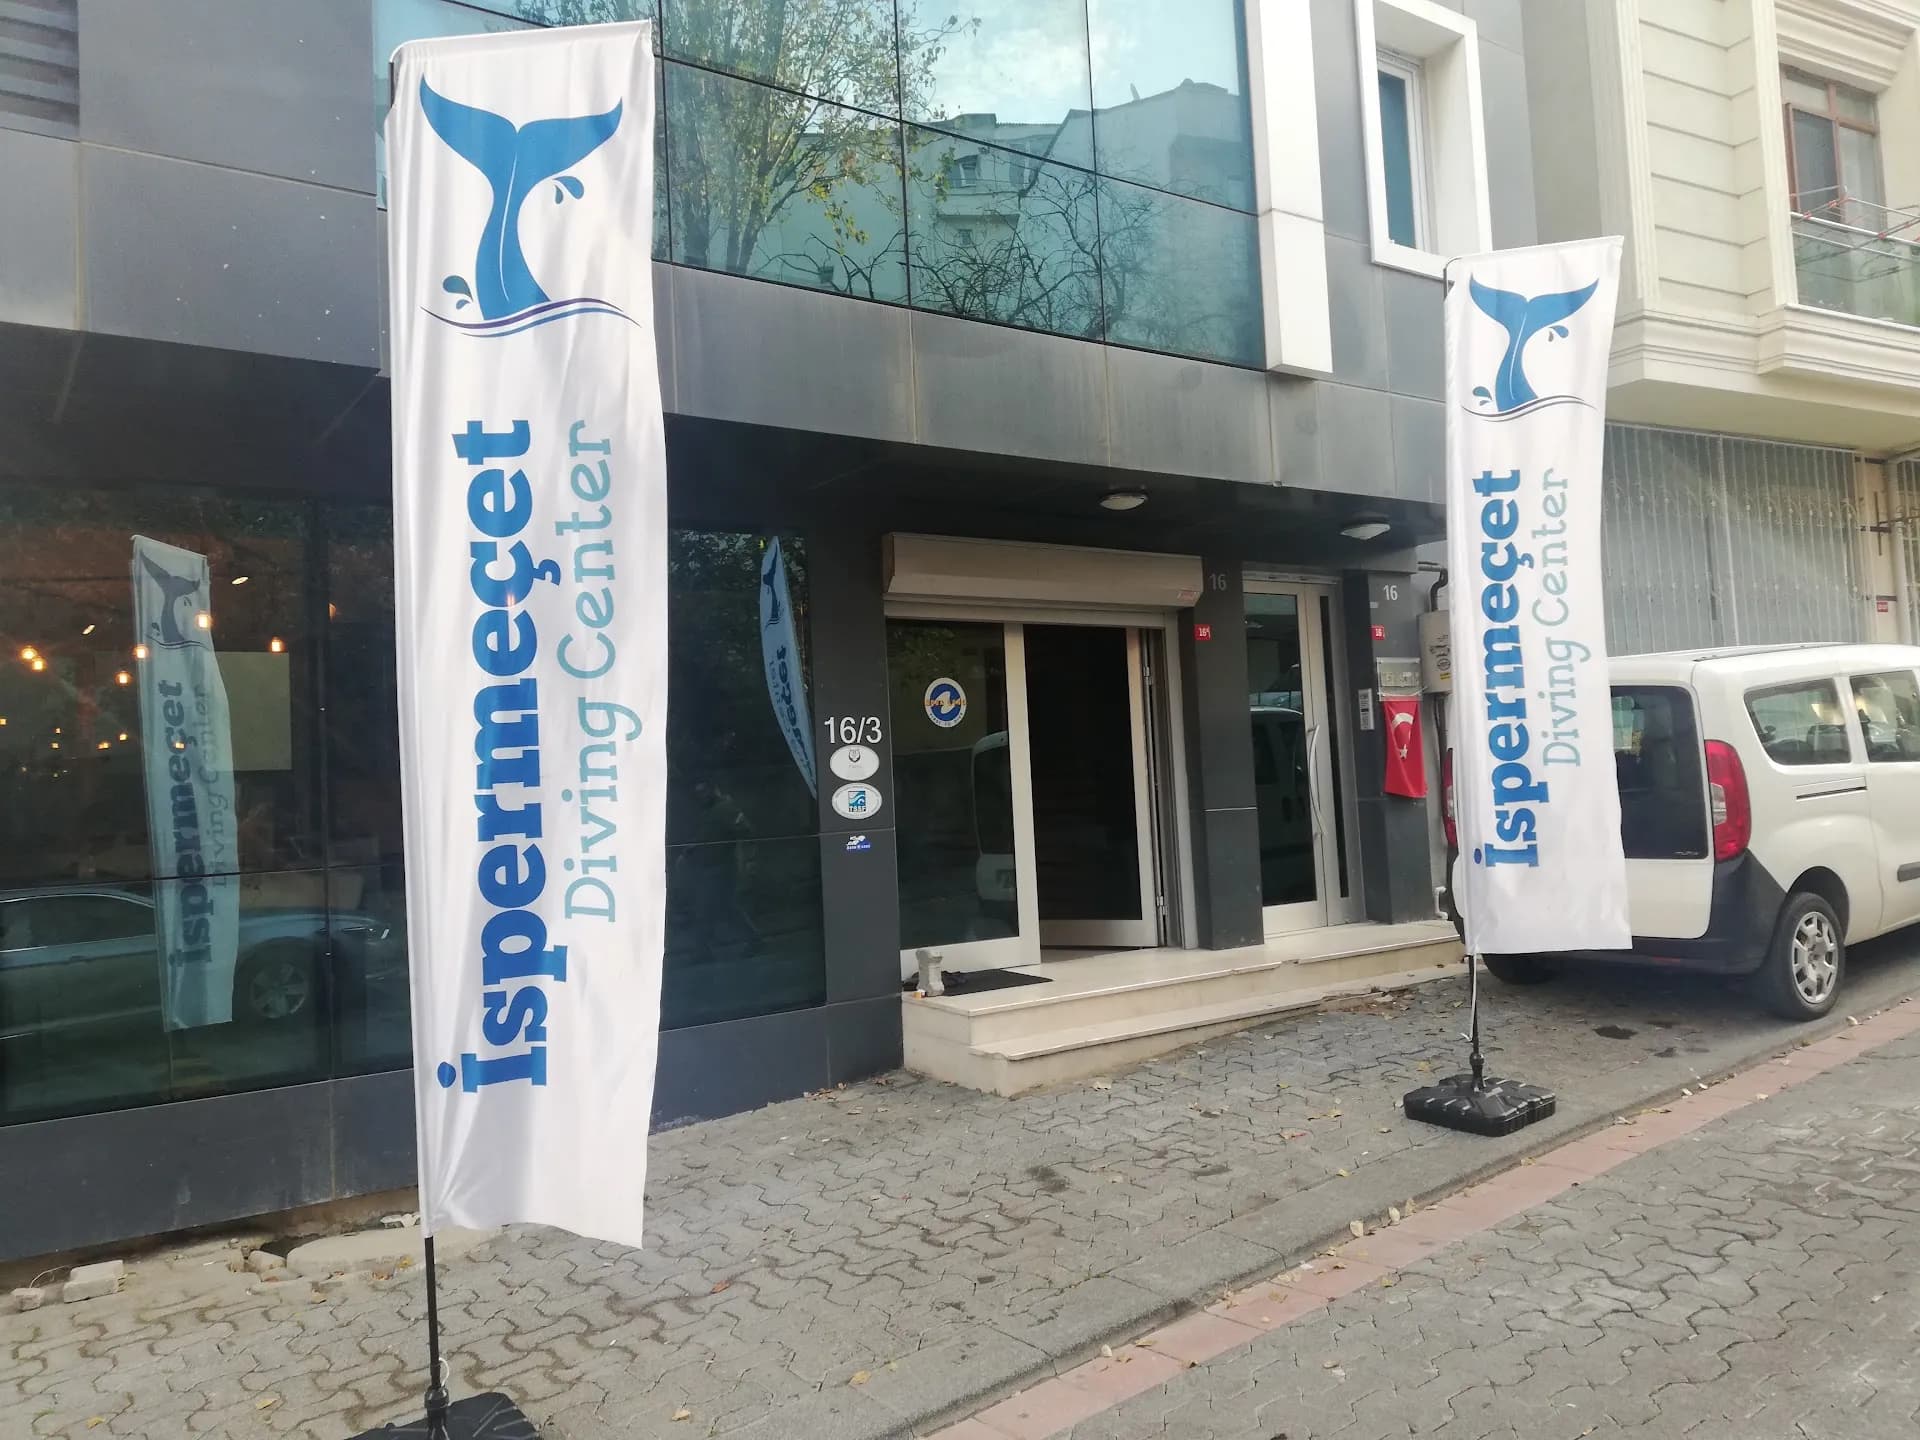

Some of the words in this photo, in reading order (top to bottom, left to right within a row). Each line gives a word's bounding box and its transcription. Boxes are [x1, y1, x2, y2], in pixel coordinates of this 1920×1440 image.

[555, 420, 615, 679] Center
[1209, 574, 1227, 591] 16
[1383, 584, 1398, 601] 16
[1532, 468, 1568, 626] Center
[824, 716, 882, 744] 16/3
[1473, 469, 1549, 868] İspermeçet
[1542, 637, 1590, 767] Diving
[438, 420, 567, 1092] İspermeçet
[563, 697, 642, 923] Diving
